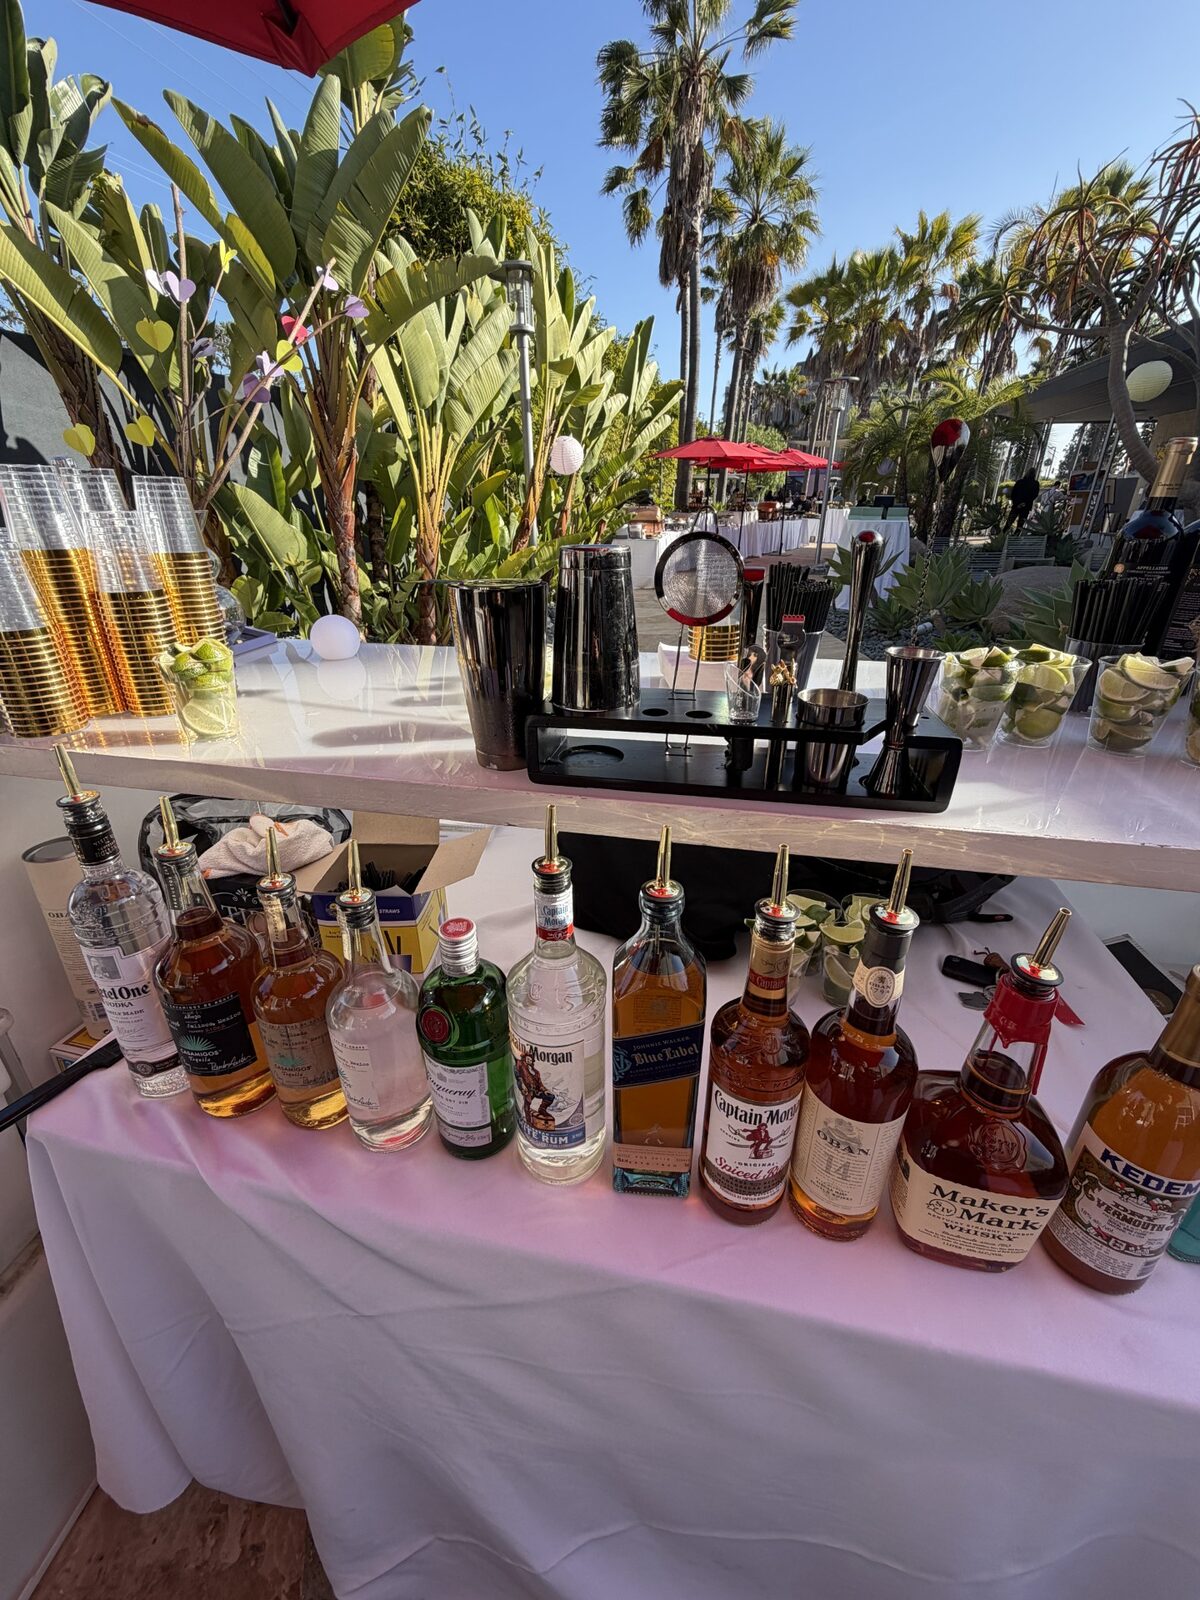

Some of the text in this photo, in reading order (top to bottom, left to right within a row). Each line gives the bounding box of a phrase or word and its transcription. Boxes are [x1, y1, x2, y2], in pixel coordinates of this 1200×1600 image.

[543, 904, 569, 917] Captain
[869, 981, 891, 989] OBAN
[526, 1044, 573, 1066] Morgan
[631, 1043, 699, 1067] Blue Label
[632, 1041, 662, 1051] JOHNNIE
[714, 1089, 763, 1126] Captain
[541, 1135, 570, 1145] RUM
[816, 1129, 871, 1156] OBAN
[714, 1156, 763, 1180] Spiced
[824, 1152, 851, 1182] 14
[1100, 1147, 1200, 1196] KEDEM
[929, 1183, 1050, 1218] Maker's
[1111, 1200, 1159, 1223] DRY
[927, 1212, 964, 1226] KENTUCKY
[966, 1223, 1001, 1234] STRAIGHT
[957, 1208, 1042, 1231] Mark
[1096, 1197, 1167, 1233] VERMOUTH
[943, 1221, 1020, 1242] WHISKY
